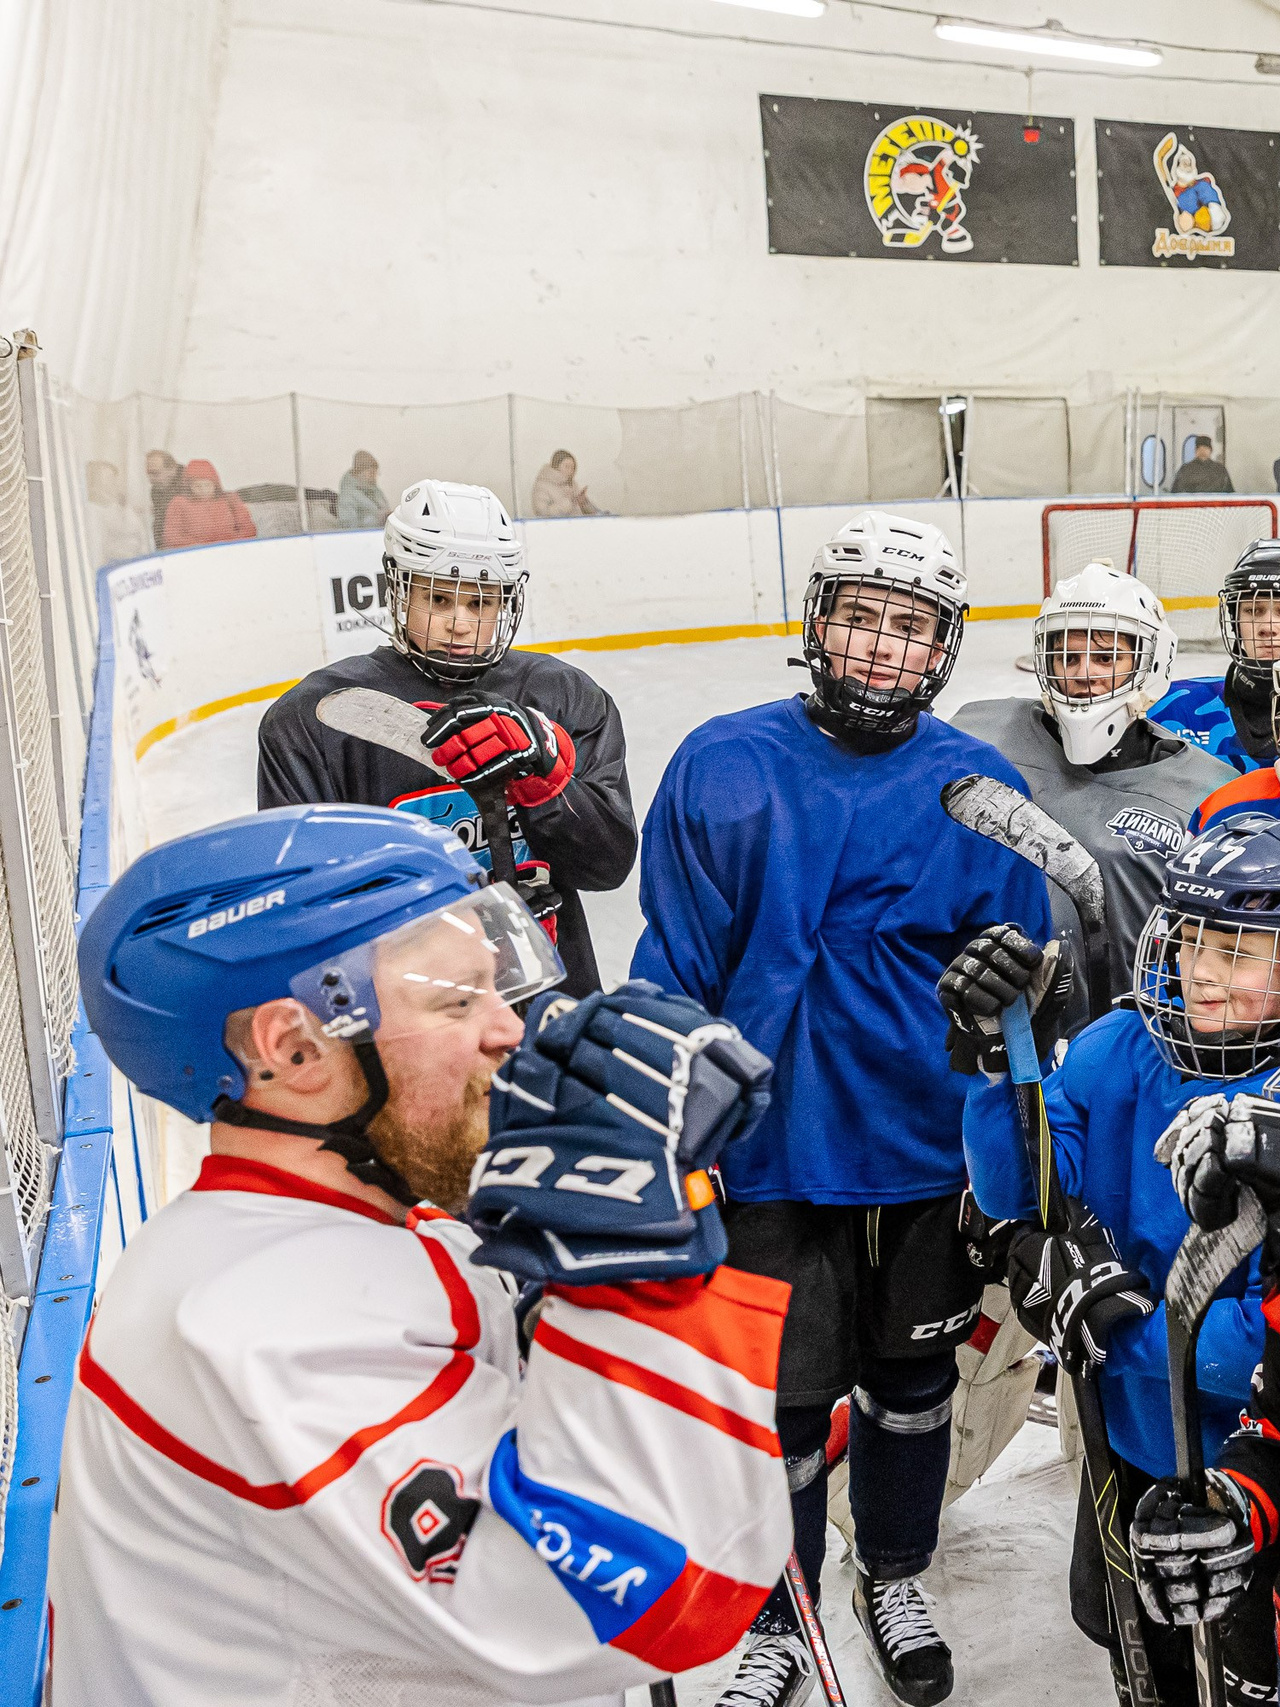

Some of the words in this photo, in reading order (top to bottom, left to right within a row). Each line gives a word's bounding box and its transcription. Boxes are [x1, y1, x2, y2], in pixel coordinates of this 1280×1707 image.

[881, 546, 925, 562] CCM
[849, 701, 896, 718] CCM
[1108, 811, 1183, 852] ДИНАМО
[1181, 841, 1247, 878] 47
[1174, 880, 1226, 900] CCM
[187, 889, 287, 940] BAUER
